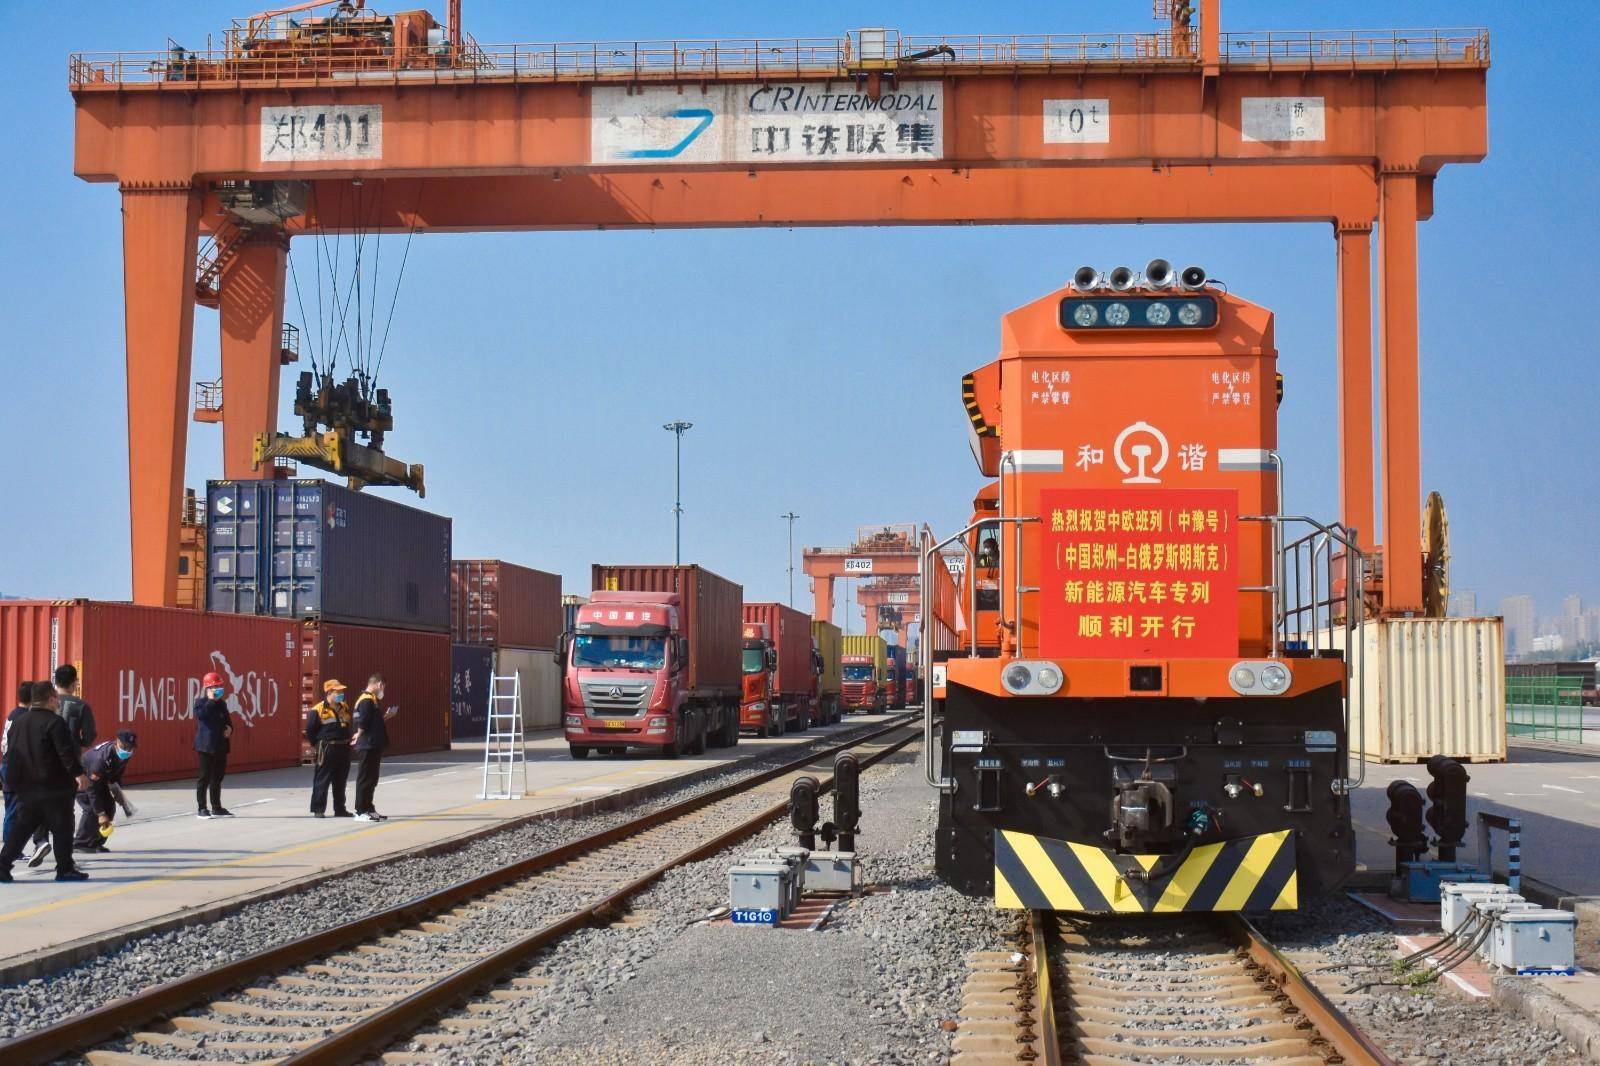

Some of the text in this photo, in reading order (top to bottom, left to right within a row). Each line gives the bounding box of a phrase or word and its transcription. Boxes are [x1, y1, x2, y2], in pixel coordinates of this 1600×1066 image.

[267, 112, 370, 155] 郑401
[751, 123, 936, 155] 中铁联集
[1075, 443, 1208, 472] 和 谐
[1065, 580, 1210, 604] 新能源汽车专列
[1078, 614, 1196, 638] 顺利开行
[119, 669, 206, 722] HAMBUR
